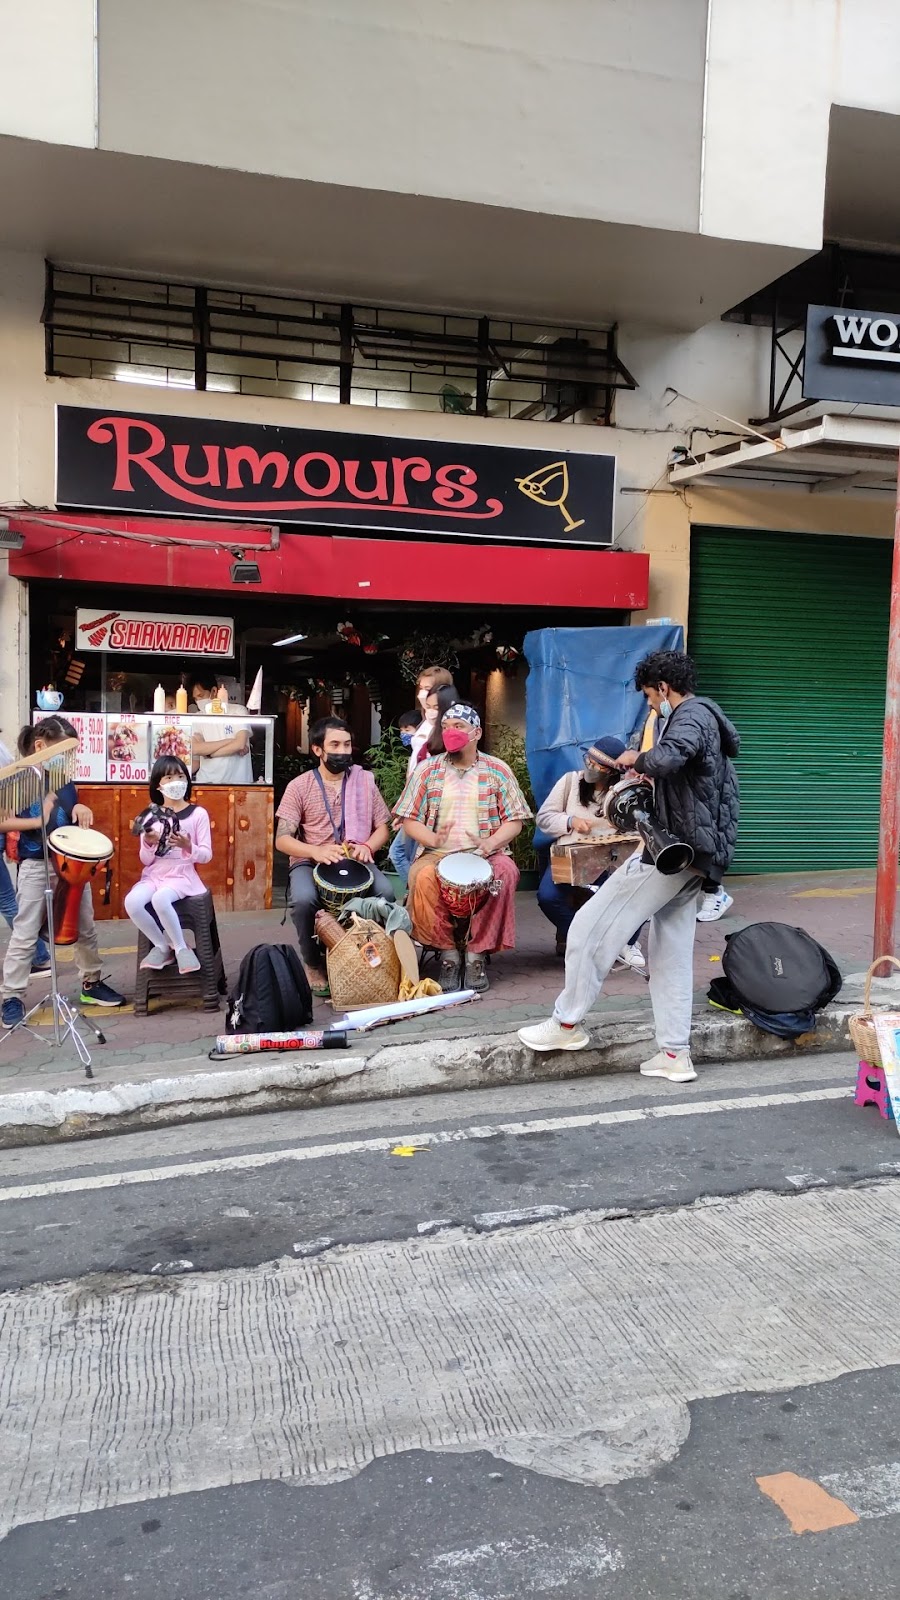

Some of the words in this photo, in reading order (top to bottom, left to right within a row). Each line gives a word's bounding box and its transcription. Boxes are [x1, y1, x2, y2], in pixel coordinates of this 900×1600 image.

[833, 314, 900, 347] WO
[87, 416, 503, 519] Rumours
[109, 619, 232, 654] SHAWARMA
[88, 717, 104, 735] 50.00
[120, 714, 136, 723] PITA
[164, 716, 181, 725] RICE
[88, 737, 104, 754] 70.00
[110, 763, 117, 780] P
[119, 763, 147, 780] 50.00
